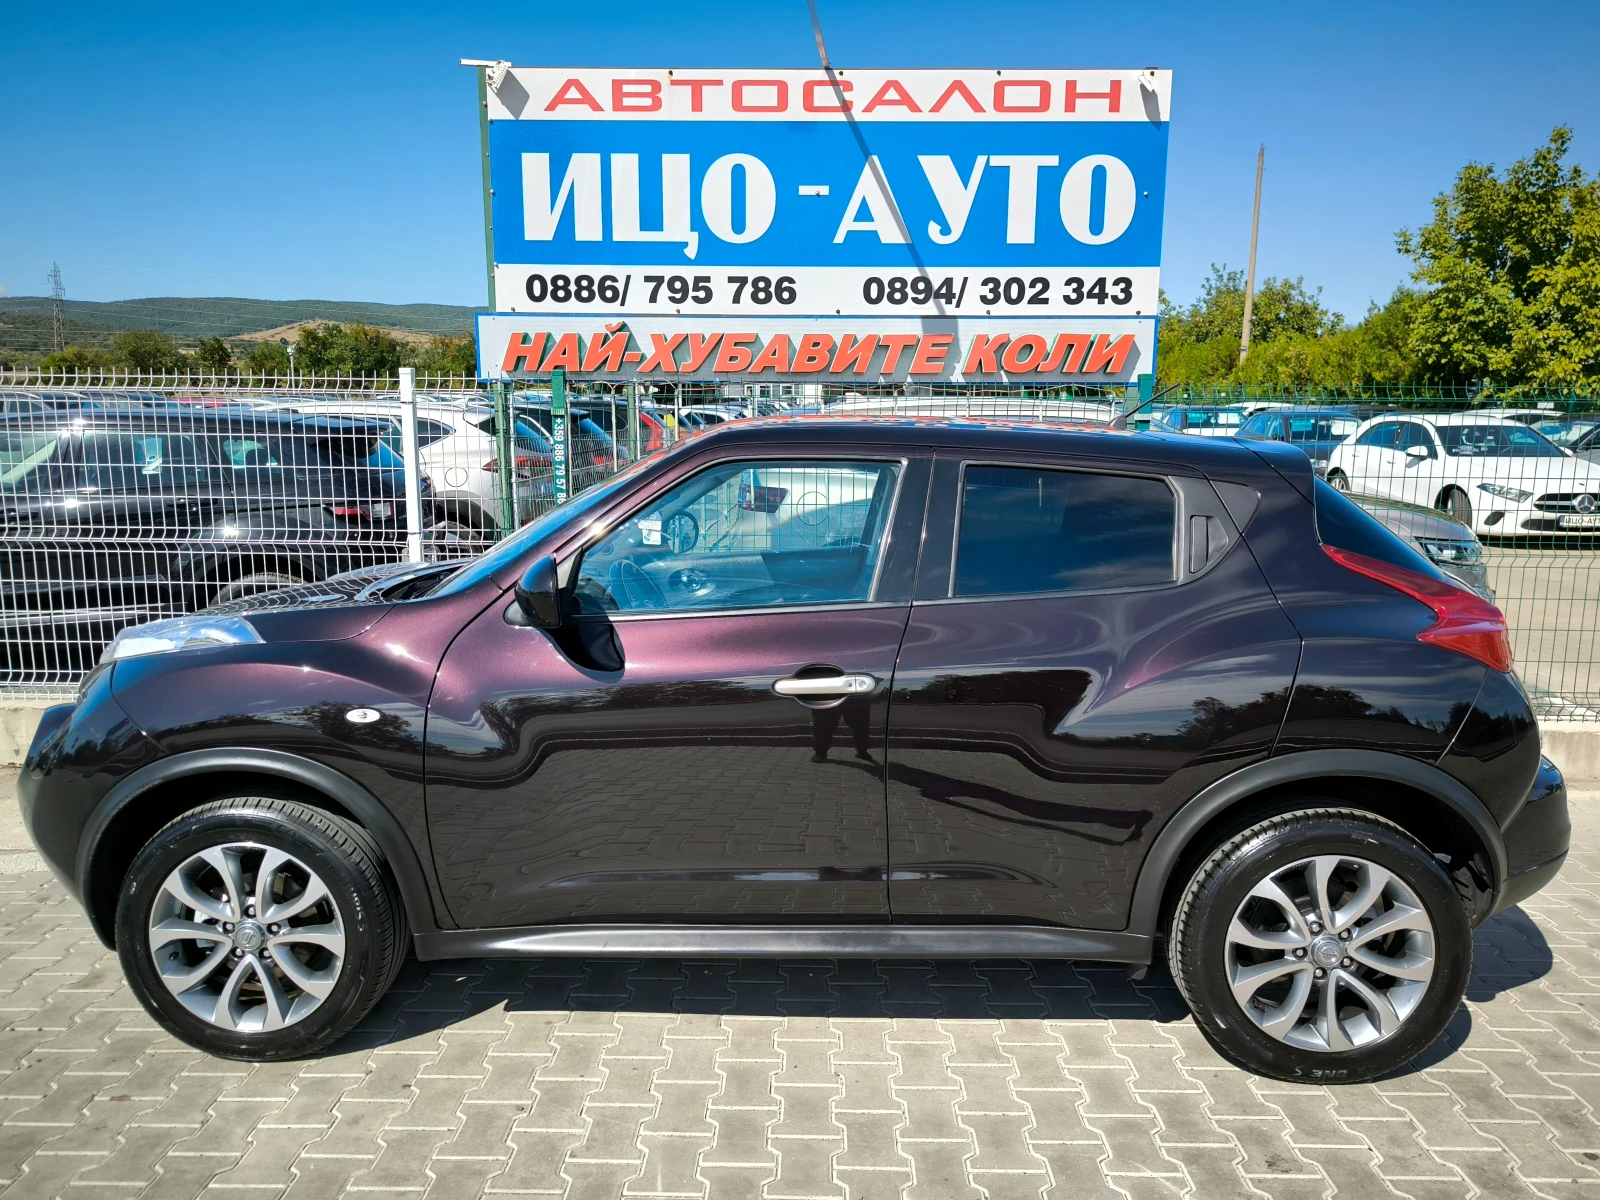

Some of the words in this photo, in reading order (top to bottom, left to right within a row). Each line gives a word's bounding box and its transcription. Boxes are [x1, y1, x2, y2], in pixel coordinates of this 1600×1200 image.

[545, 78, 1121, 114] АВТОСАЛОН
[525, 274, 631, 305] 0886/
[643, 275, 712, 304] 795
[727, 275, 797, 305] 786
[862, 275, 969, 305] 0894/
[979, 276, 1050, 305] 302
[1063, 276, 1133, 305] 343
[501, 322, 954, 374] НАЙ-ХУБАВИТЕ
[964, 333, 1135, 374] КОЛИ
